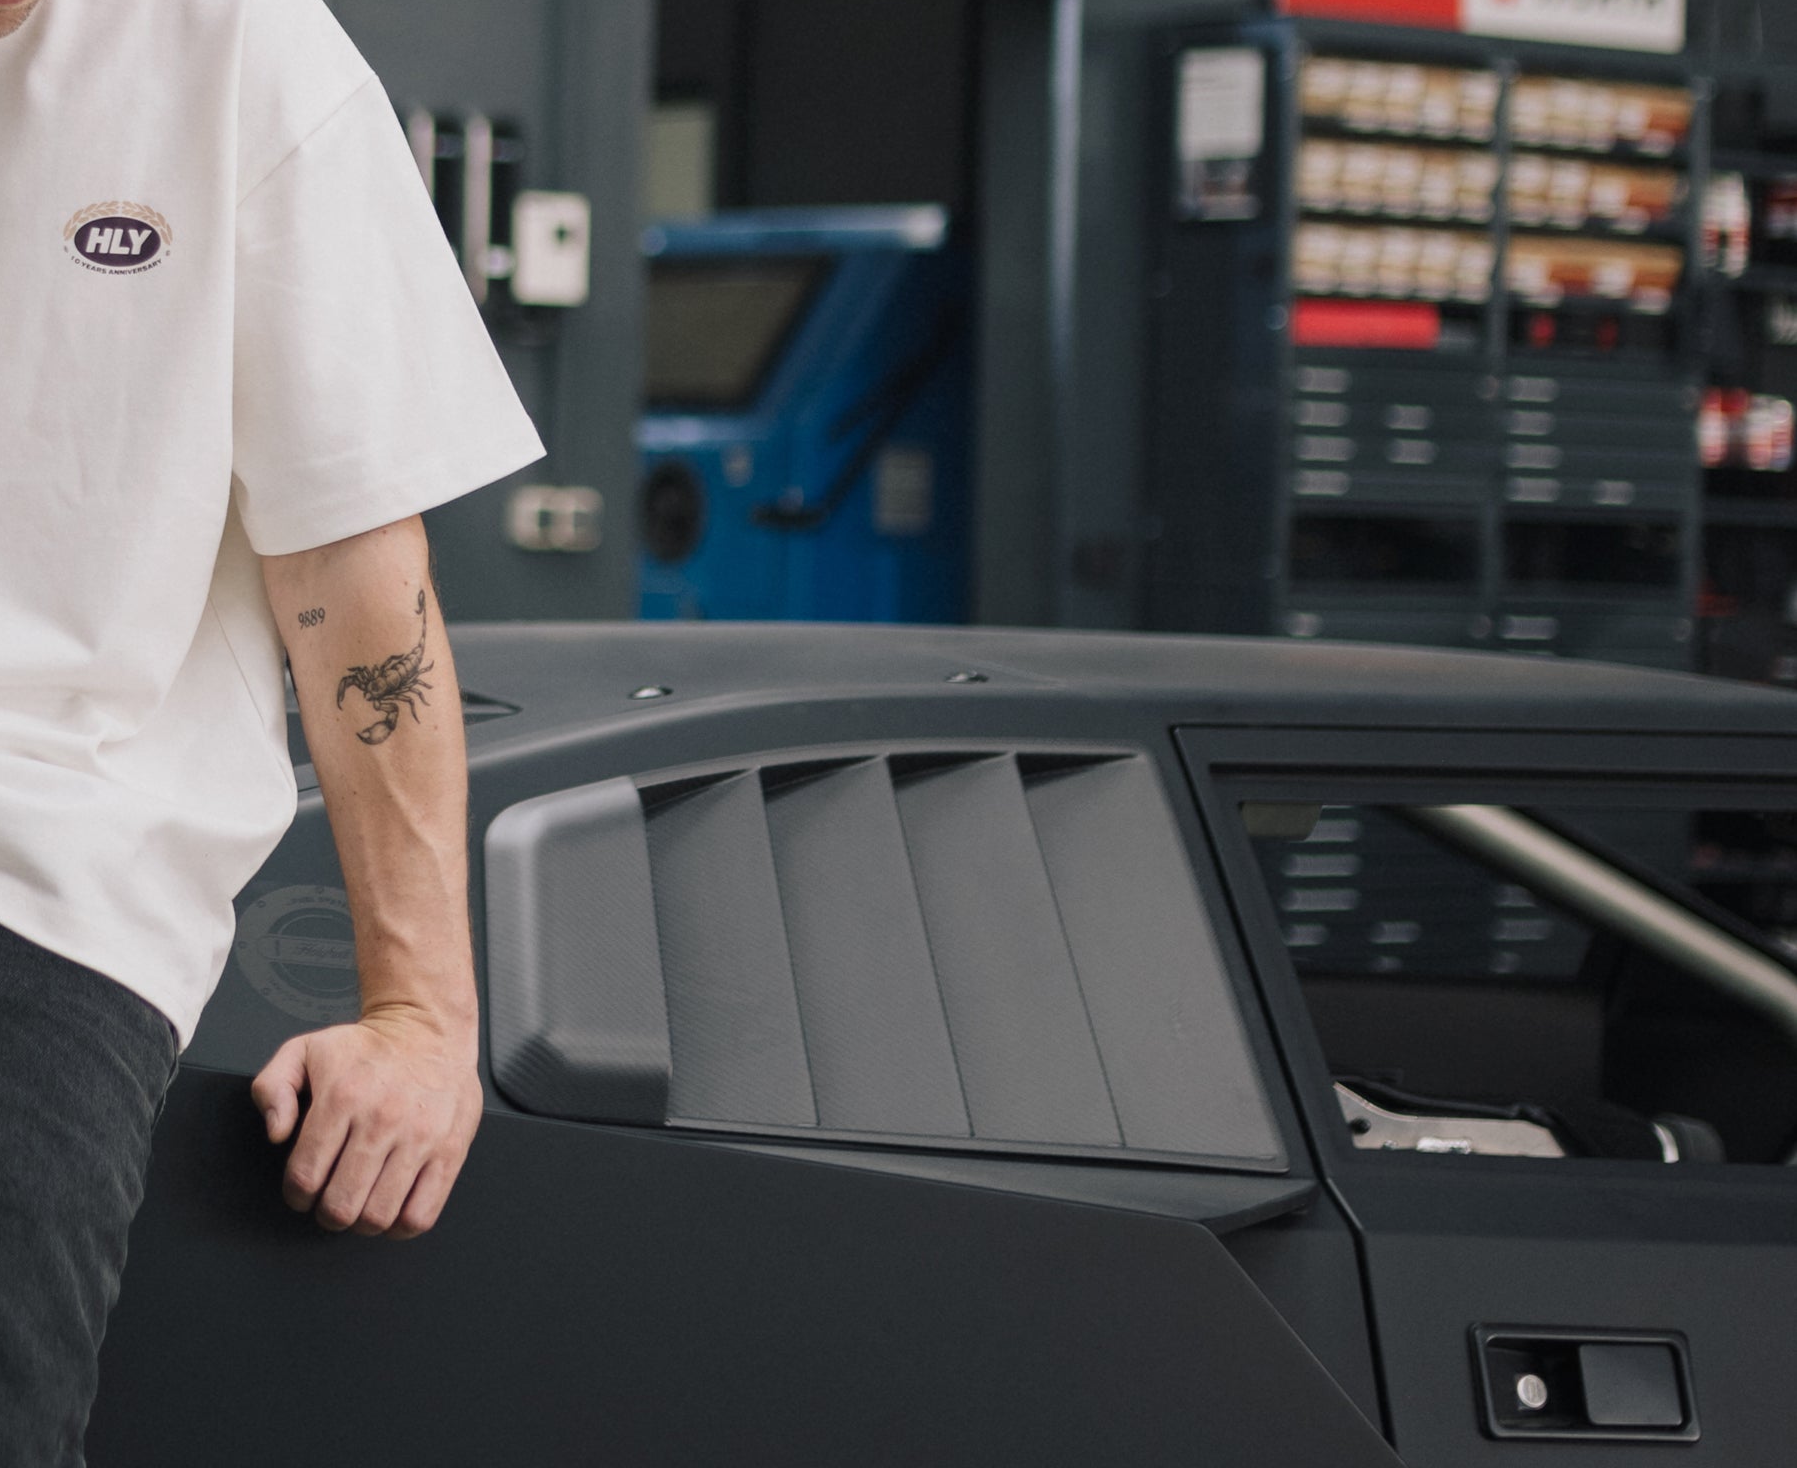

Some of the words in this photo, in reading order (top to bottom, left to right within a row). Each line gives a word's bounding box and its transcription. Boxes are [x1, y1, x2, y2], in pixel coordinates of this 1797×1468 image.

[85, 227, 152, 255] HLY
[82, 261, 107, 275] YEARS
[108, 258, 162, 276] ANNIVERSARY
[298, 607, 326, 630] 9889
